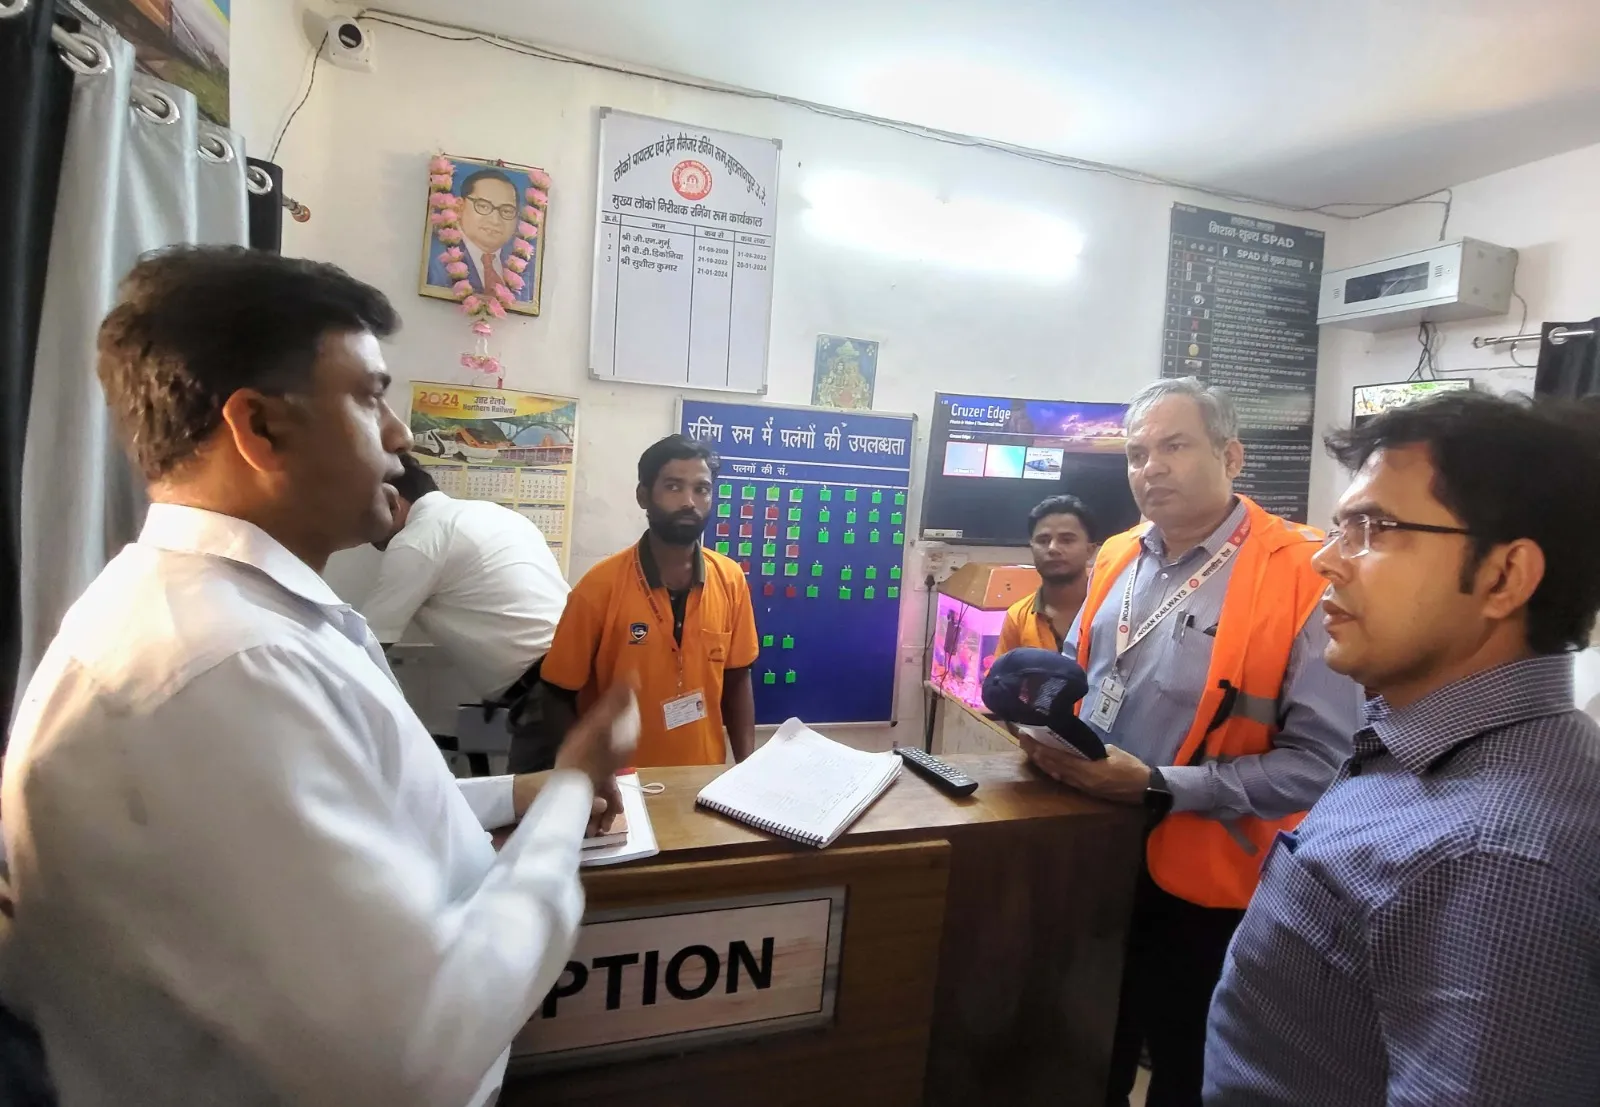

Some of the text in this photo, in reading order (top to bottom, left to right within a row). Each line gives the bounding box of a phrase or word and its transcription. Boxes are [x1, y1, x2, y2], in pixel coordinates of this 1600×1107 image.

[613, 153, 631, 182] लोको
[612, 194, 764, 227] मुख्य लोको निरीक्षक रनिंग रूम कार्यकाल
[1261, 233, 1295, 248] SPAD
[1236, 249, 1260, 261] SPAD
[632, 259, 655, 269] सुशील
[656, 263, 678, 272] कुमार
[419, 391, 459, 407] 2024
[462, 403, 517, 415] Northern Railway
[951, 403, 1011, 422] Cruzer Edge
[688, 415, 723, 442] रनिंग
[761, 416, 774, 446] में
[780, 423, 816, 449] पलंगों
[824, 426, 841, 451] की
[848, 434, 906, 456] उपलब्धता
[761, 464, 773, 475] की
[1137, 589, 1187, 638] INDIAN RAILWAYS
[541, 937, 774, 1019] PTION
